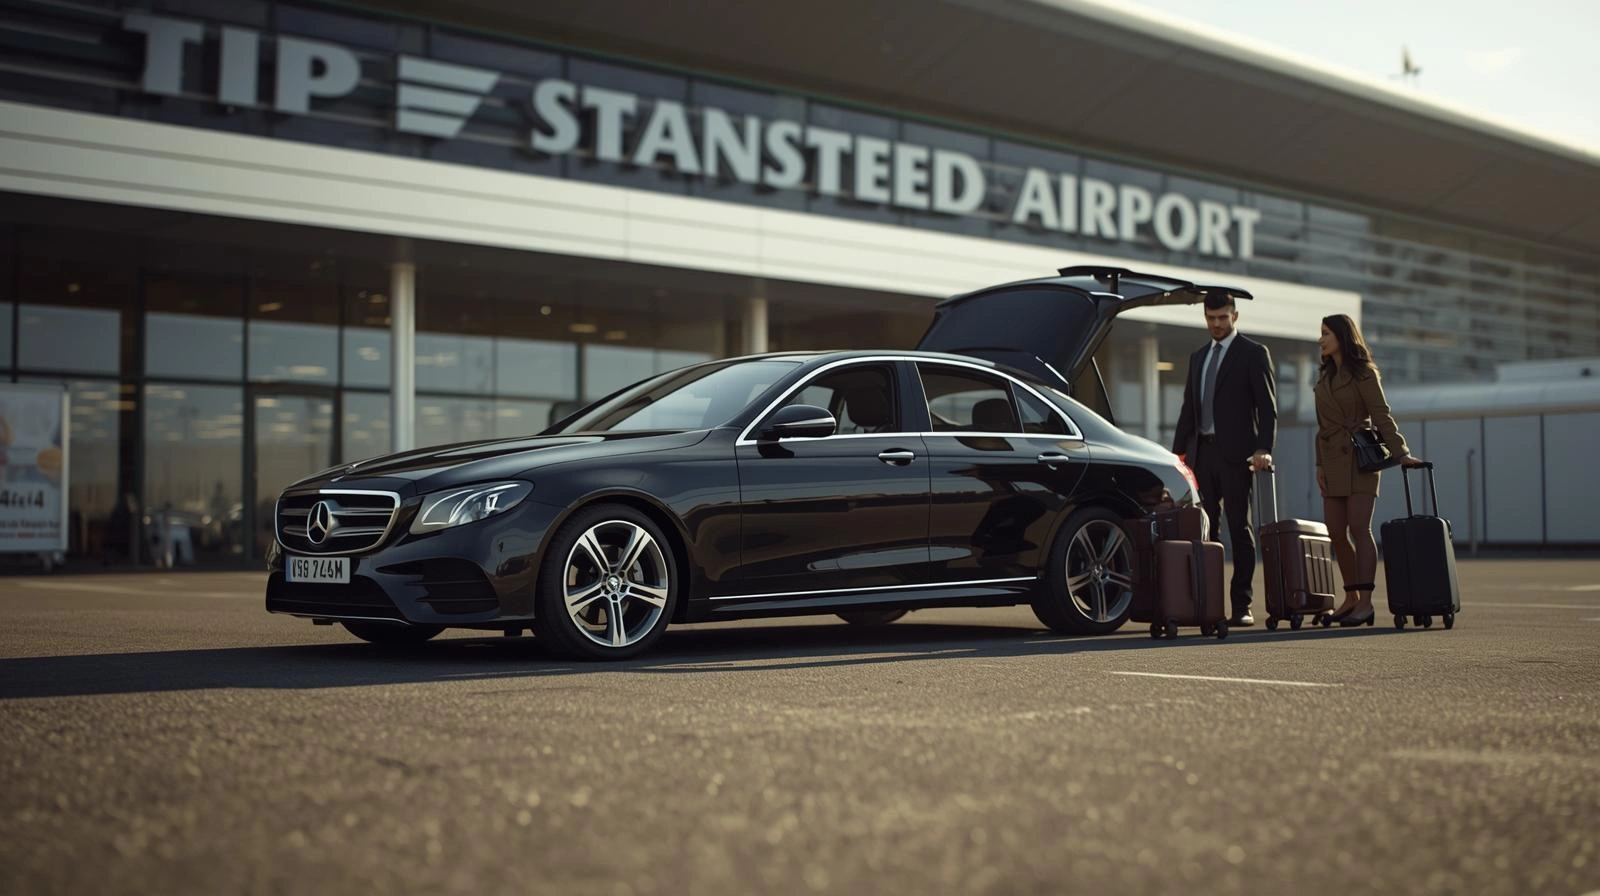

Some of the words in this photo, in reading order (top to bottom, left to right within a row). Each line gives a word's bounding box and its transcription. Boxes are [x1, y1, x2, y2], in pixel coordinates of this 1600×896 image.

[122, 13, 362, 113] TIP
[530, 78, 986, 214] STANSTEED
[1012, 166, 1262, 260] AIRPORT
